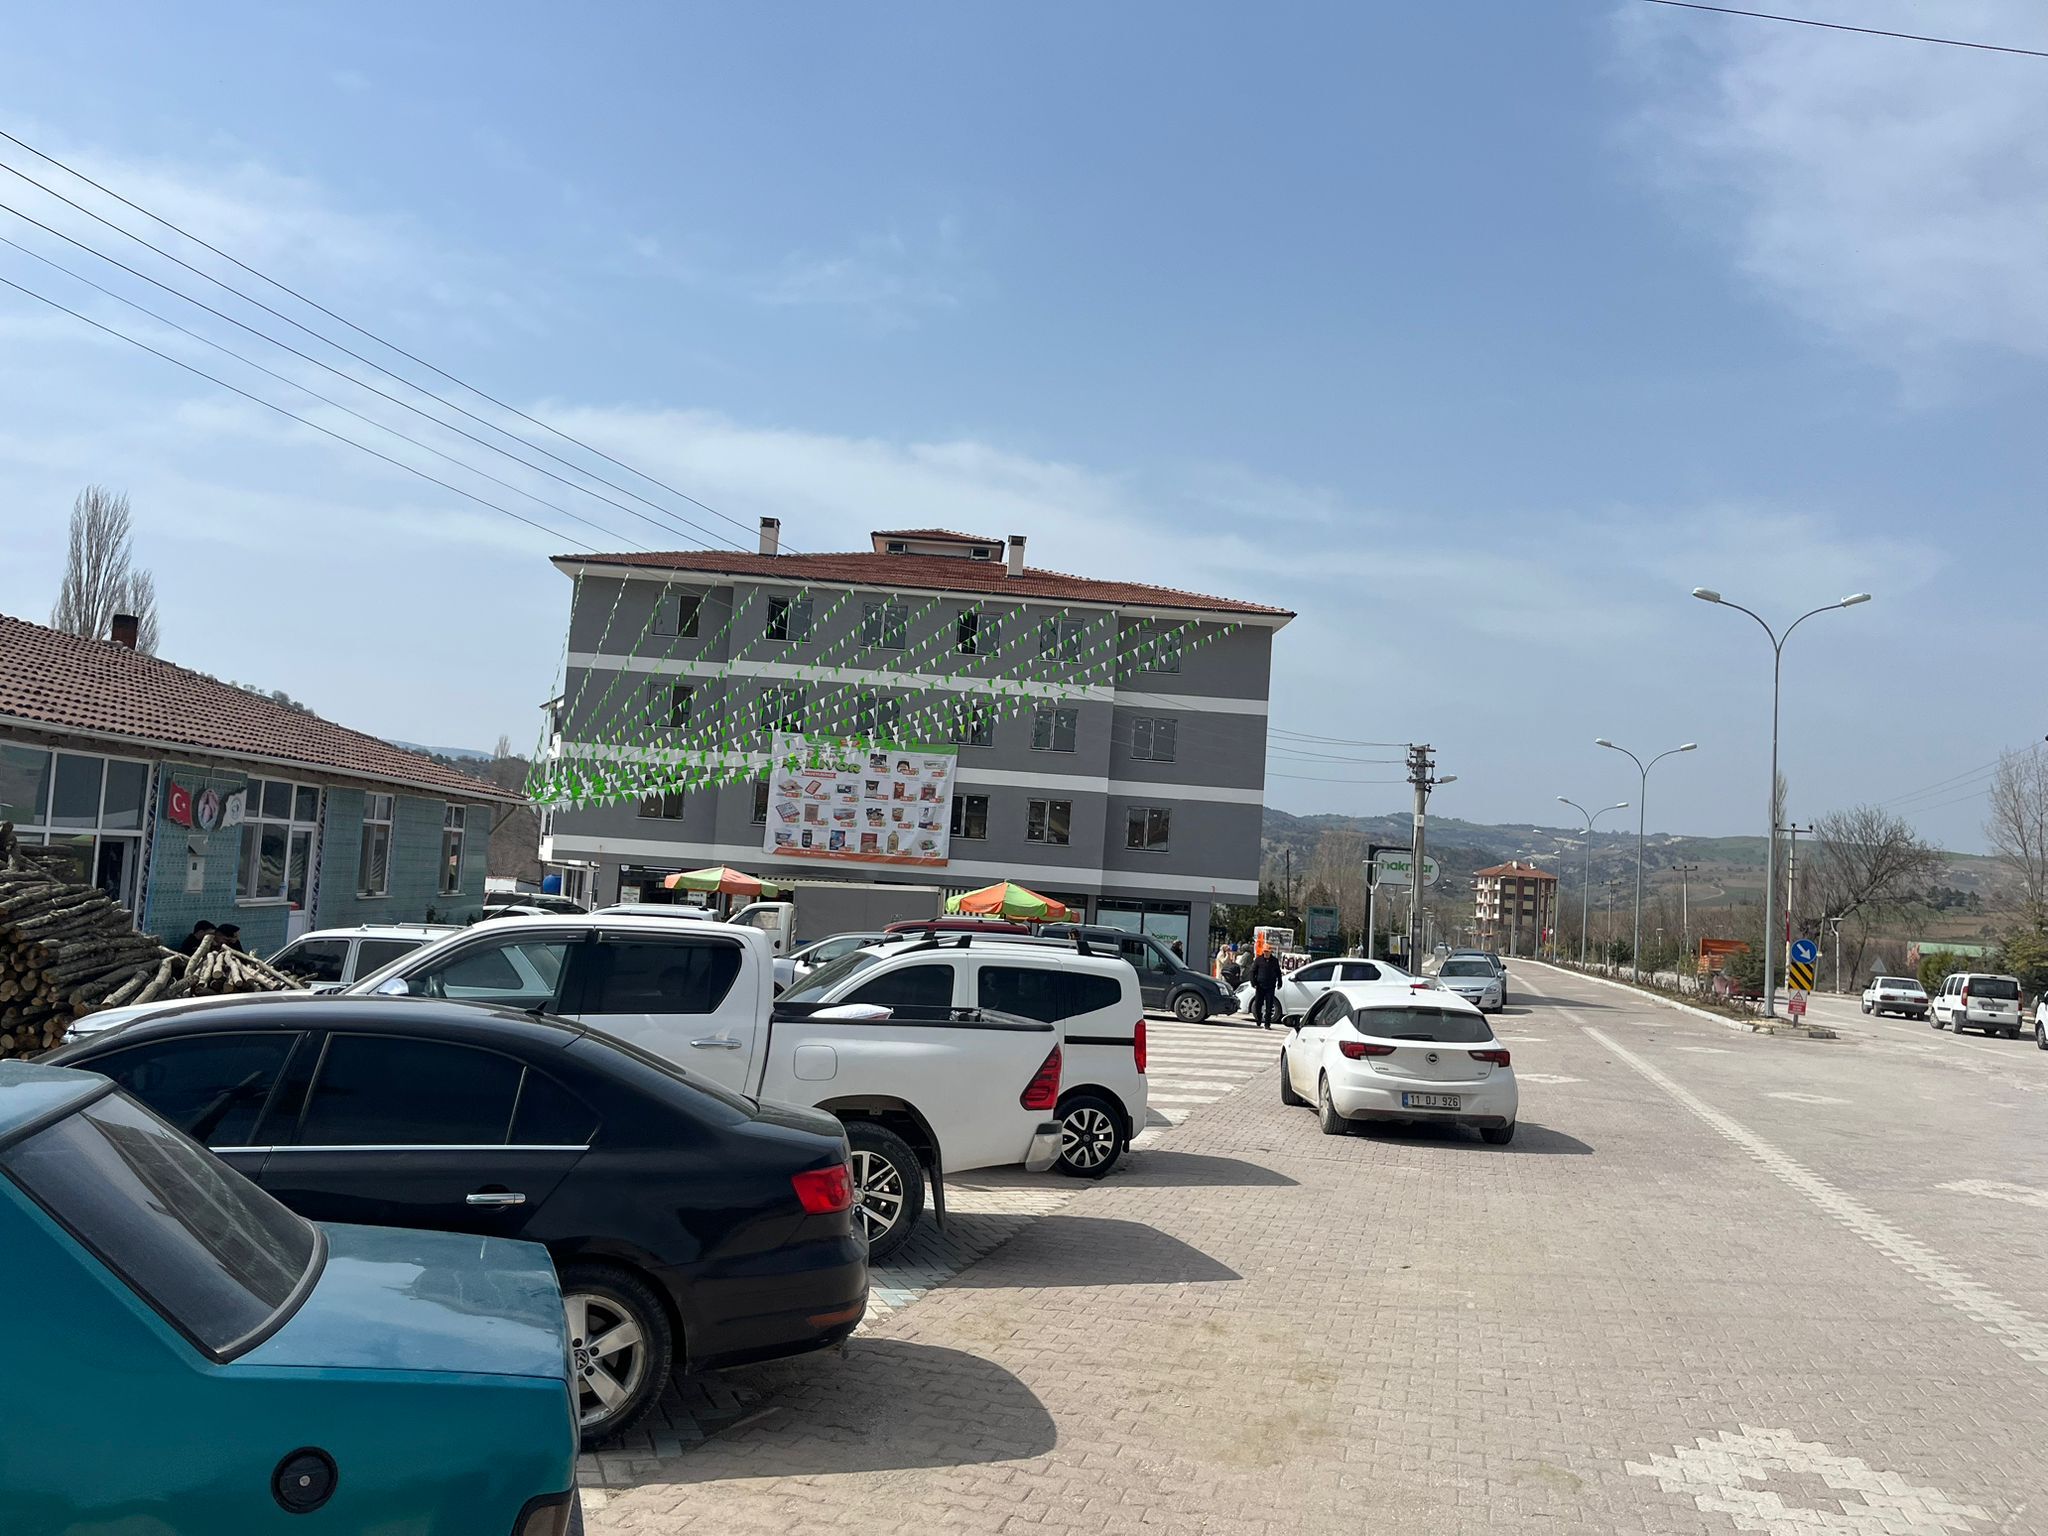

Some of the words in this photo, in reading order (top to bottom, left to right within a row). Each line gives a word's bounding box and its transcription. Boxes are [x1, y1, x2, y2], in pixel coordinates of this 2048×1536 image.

[1381, 859, 1433, 873] hakr
[1410, 1095, 1420, 1104] 11
[1442, 1096, 1458, 1107] 926
